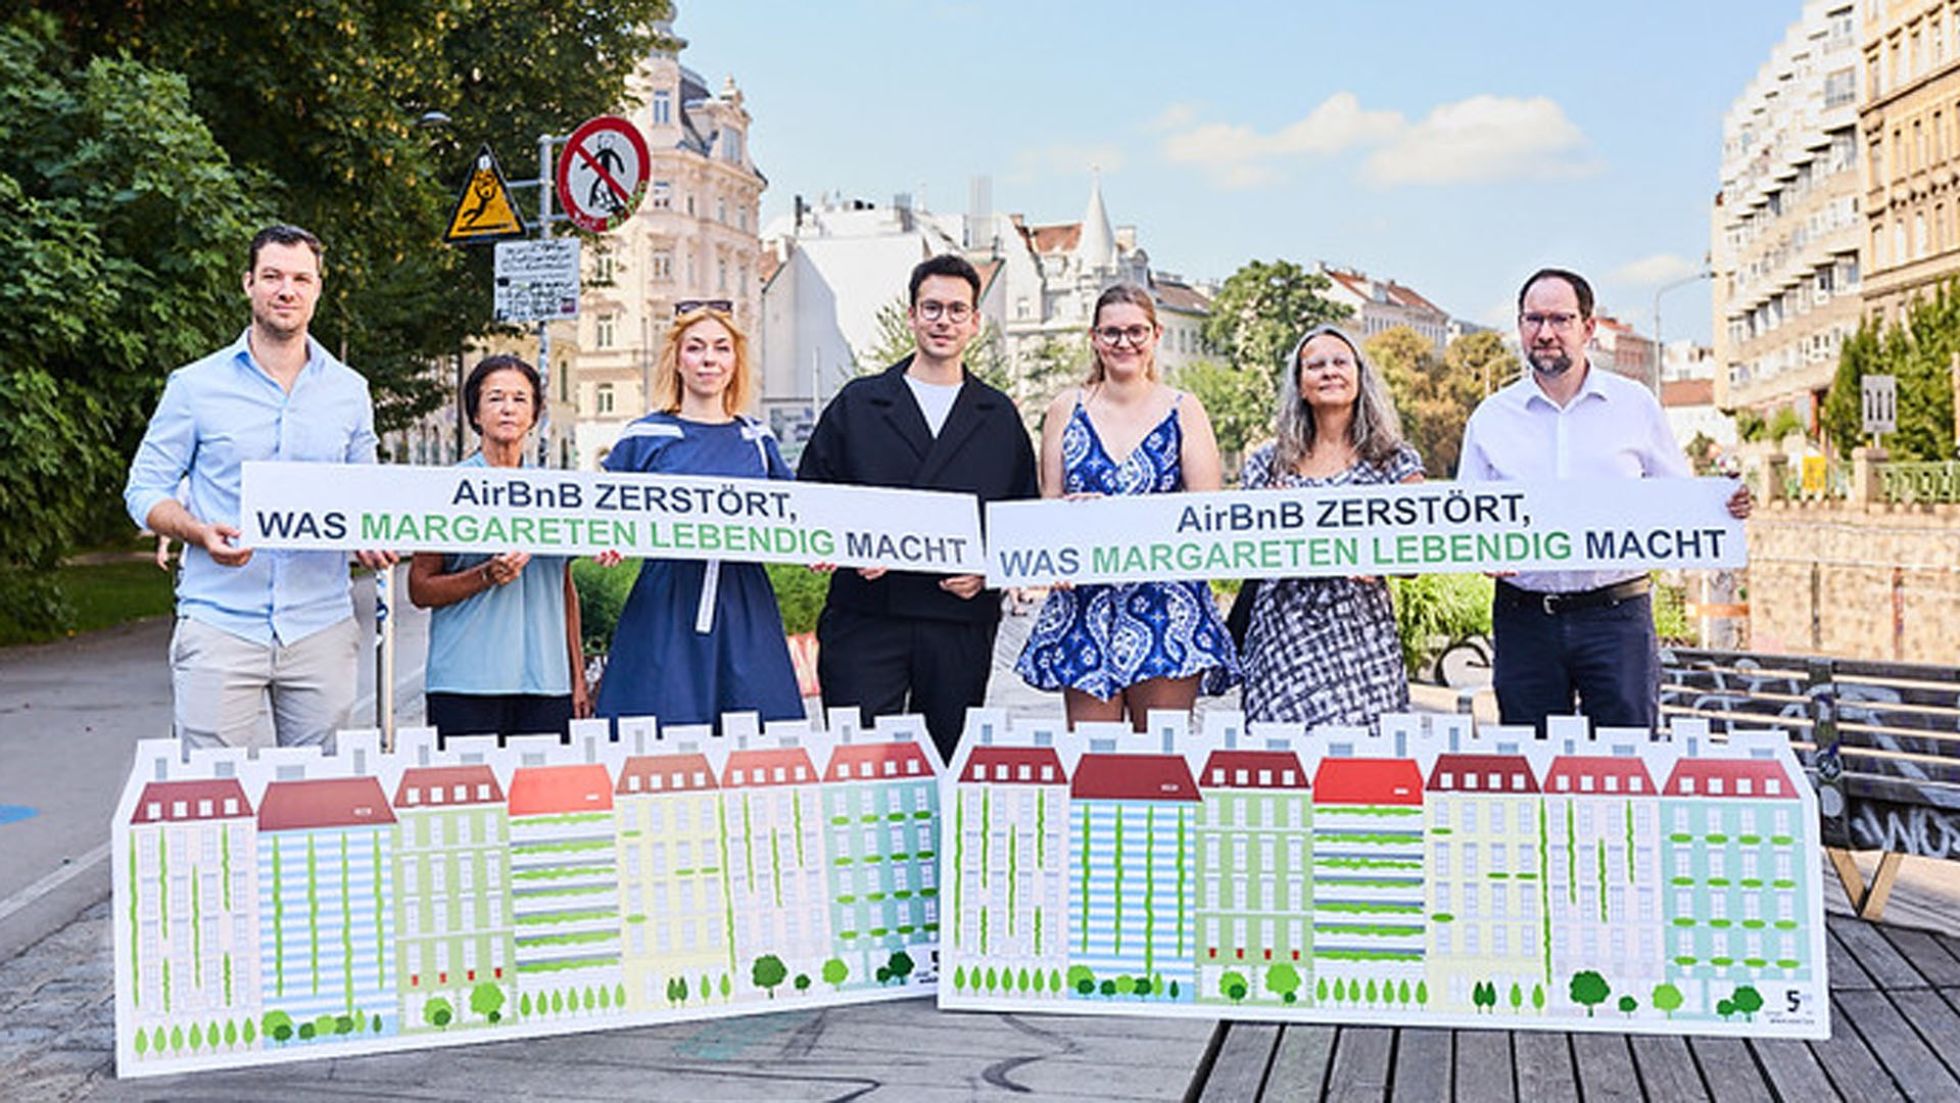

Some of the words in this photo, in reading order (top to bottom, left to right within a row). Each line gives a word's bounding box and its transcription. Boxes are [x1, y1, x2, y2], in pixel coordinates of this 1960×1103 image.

[452, 479, 584, 509] AirBnB
[594, 483, 797, 523] ZERSTÖRT,
[1177, 501, 1305, 533] AirBnB
[1316, 490, 1531, 528] ZERSTÖRT,
[257, 511, 348, 540] WAS
[361, 513, 637, 547] MARGARETEN
[651, 521, 836, 556] LEBENDIG
[846, 532, 967, 564] MACHT
[1000, 549, 1080, 578] WAS
[1092, 537, 1358, 573] MARGARETEN
[1373, 531, 1572, 564] LEBENDIG
[1586, 529, 1726, 560] MACHT
